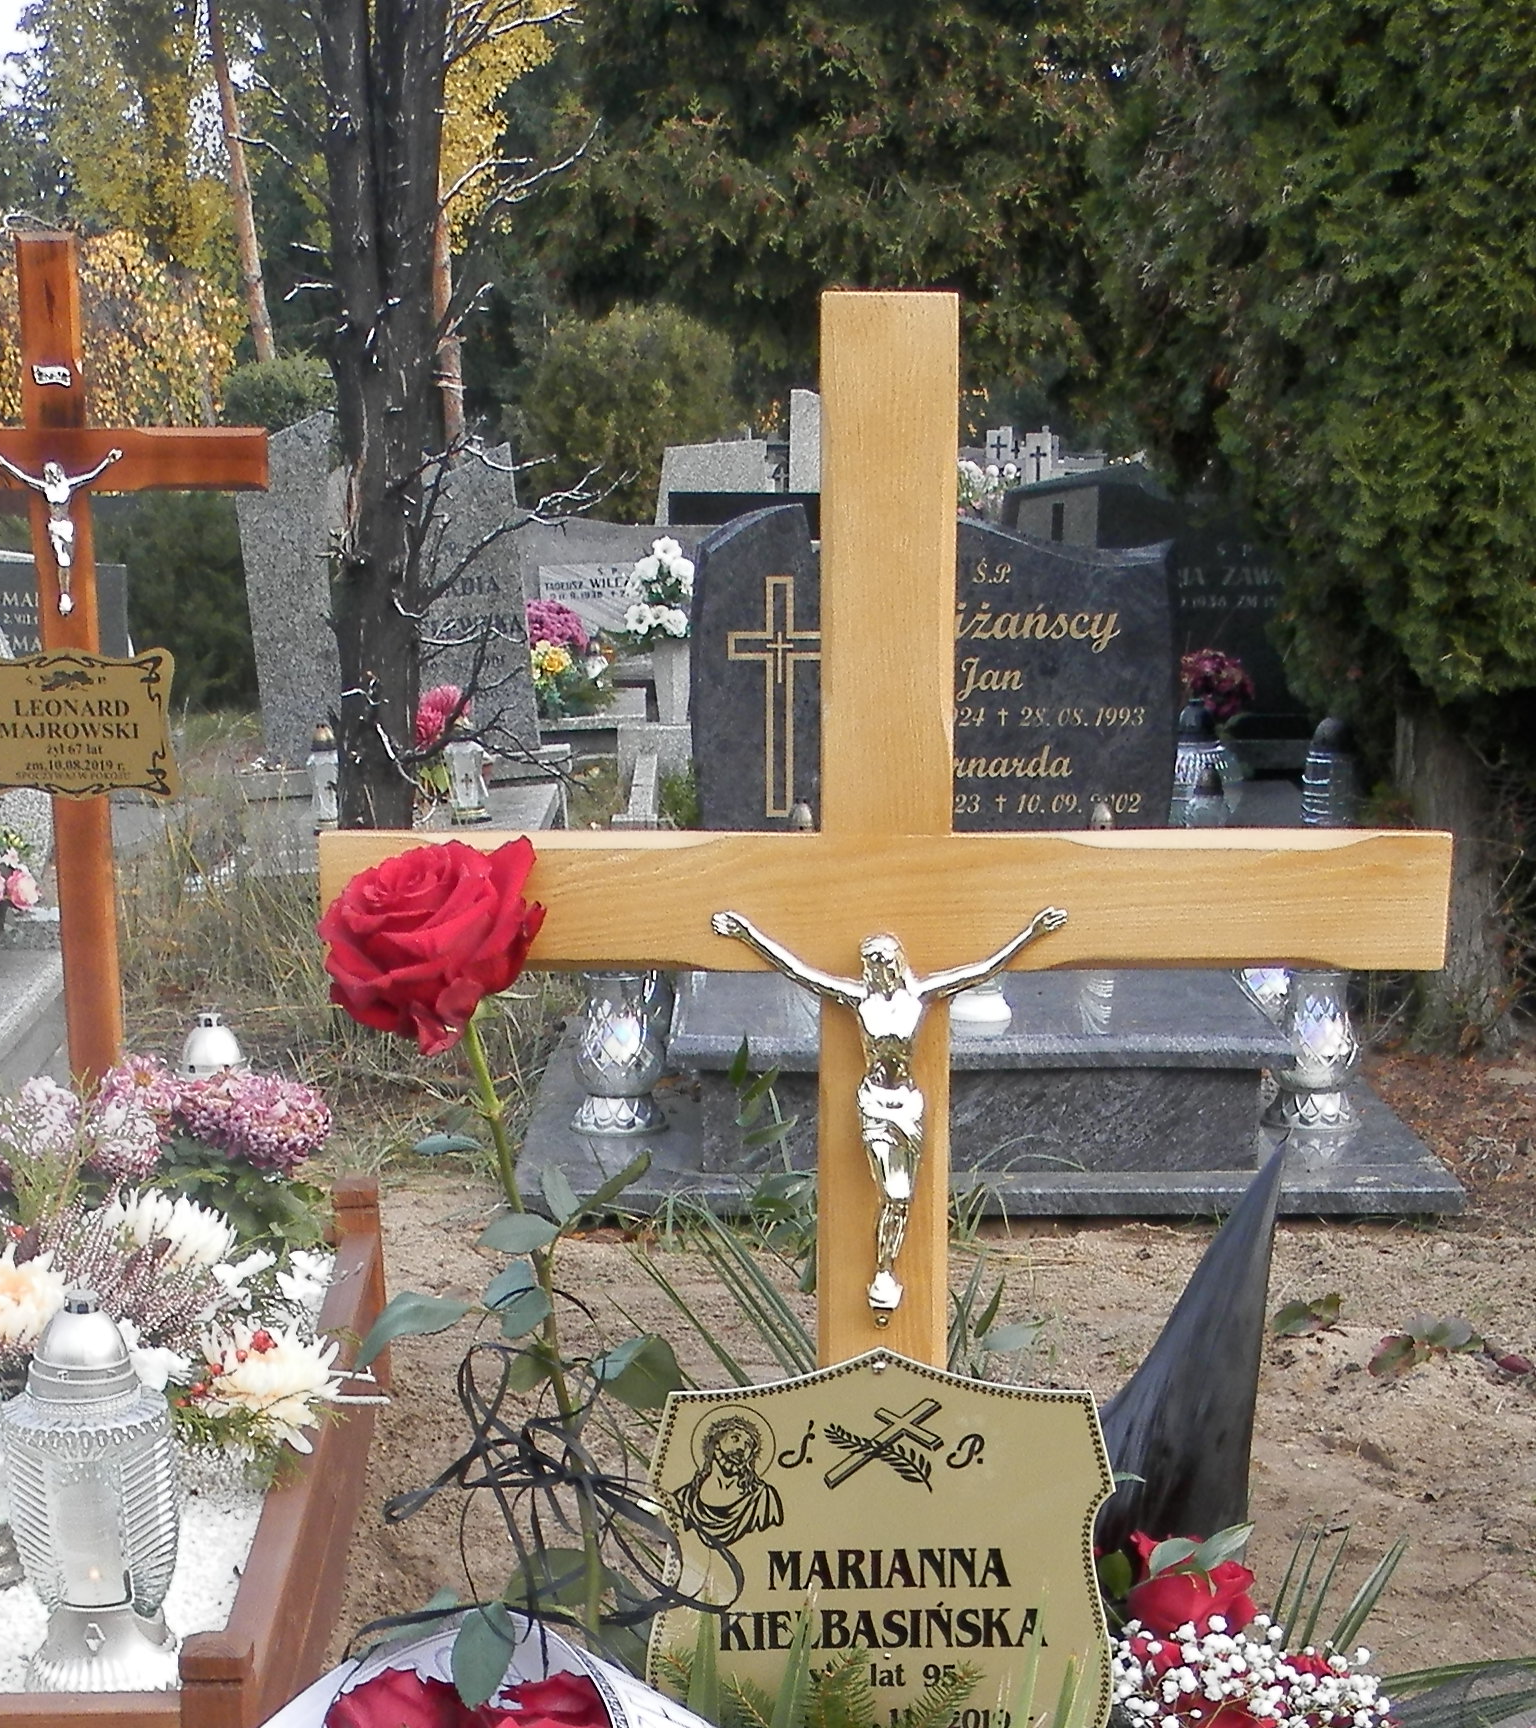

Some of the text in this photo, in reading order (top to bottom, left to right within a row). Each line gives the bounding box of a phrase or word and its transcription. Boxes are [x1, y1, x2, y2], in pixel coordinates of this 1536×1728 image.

[956, 656, 1024, 702] Jan
[14, 699, 130, 717] LEONARD
[0, 722, 139, 739] MAJROWSKI
[953, 744, 1073, 779] rnarda
[768, 1548, 1012, 1591] MARIANNA
[718, 1601, 1048, 1652] KIEBASIŃSKA
[870, 1663, 907, 1687] lat
